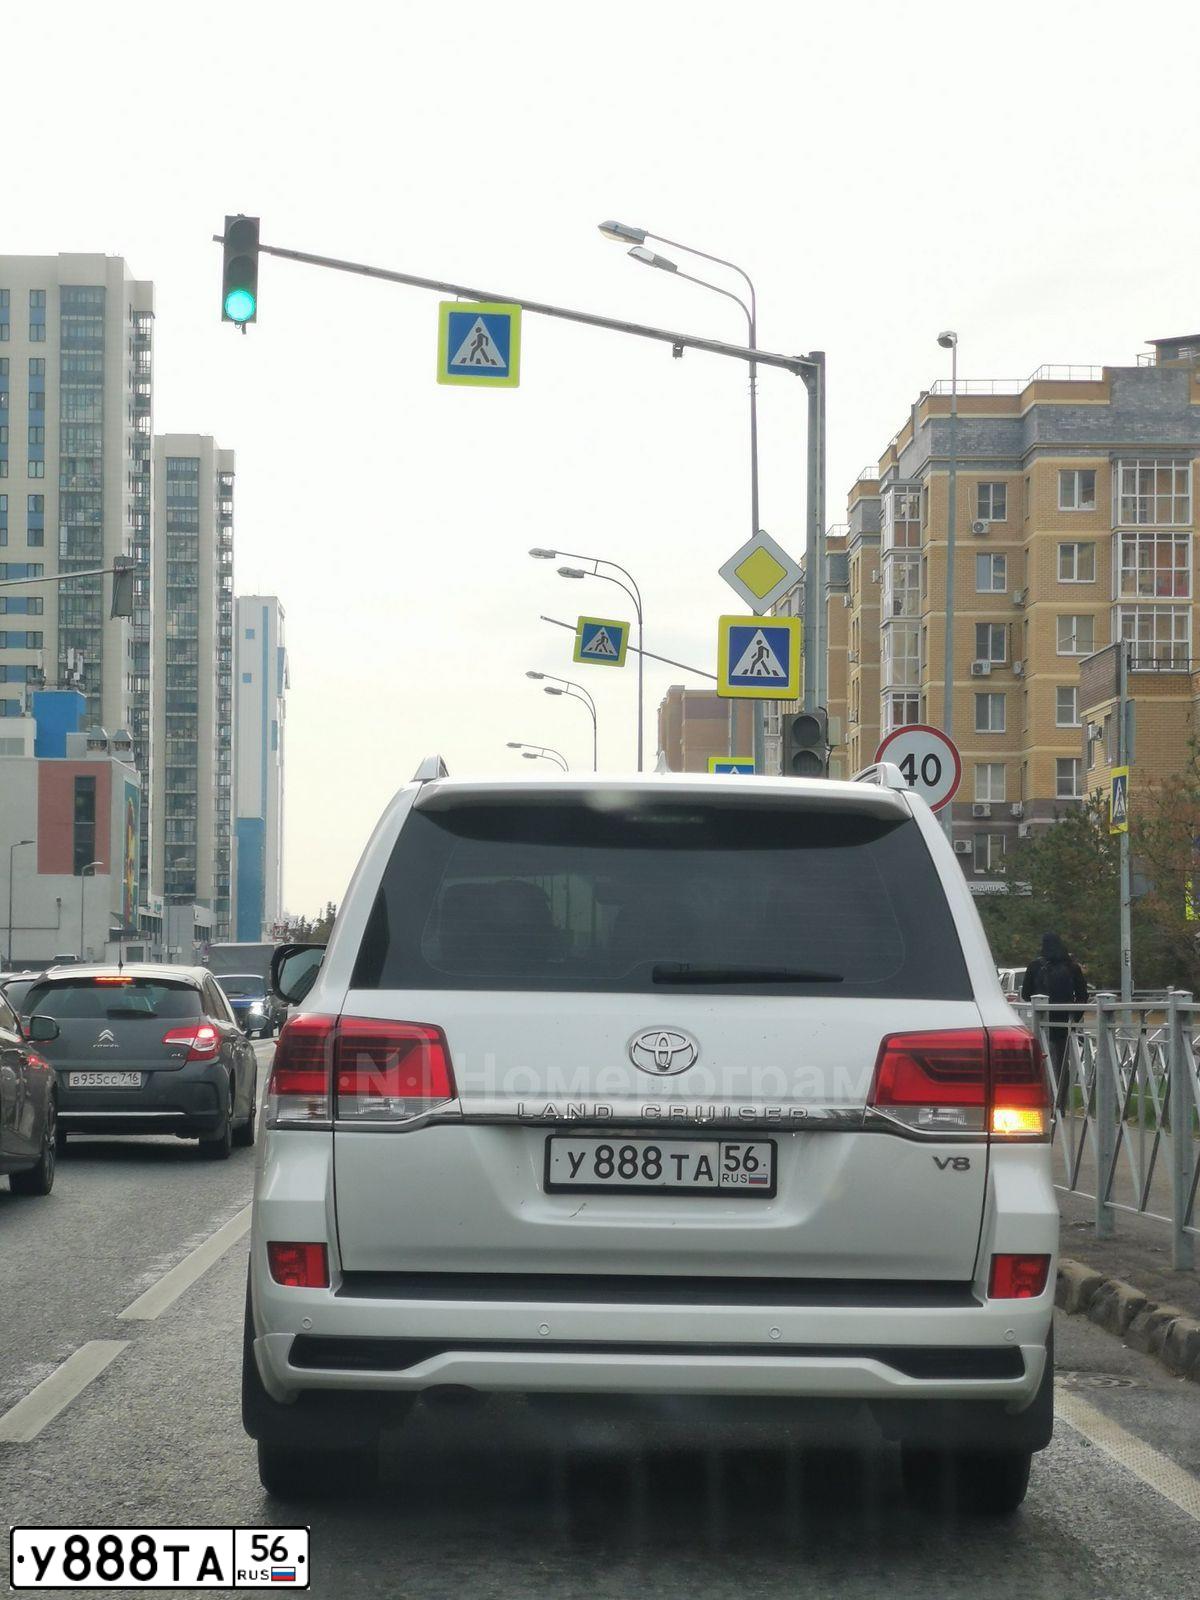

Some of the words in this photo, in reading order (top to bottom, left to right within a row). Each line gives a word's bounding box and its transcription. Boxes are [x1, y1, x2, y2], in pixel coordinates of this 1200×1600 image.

[899, 753, 942, 787] 40
[120, 1072, 139, 1082] 716
[517, 1102, 614, 1121] LAND
[641, 1103, 809, 1122] CRUISER
[567, 1144, 714, 1182] У888ТА
[724, 1145, 760, 1172] 56
[932, 1156, 971, 1171] V8
[722, 1173, 748, 1184] RUS
